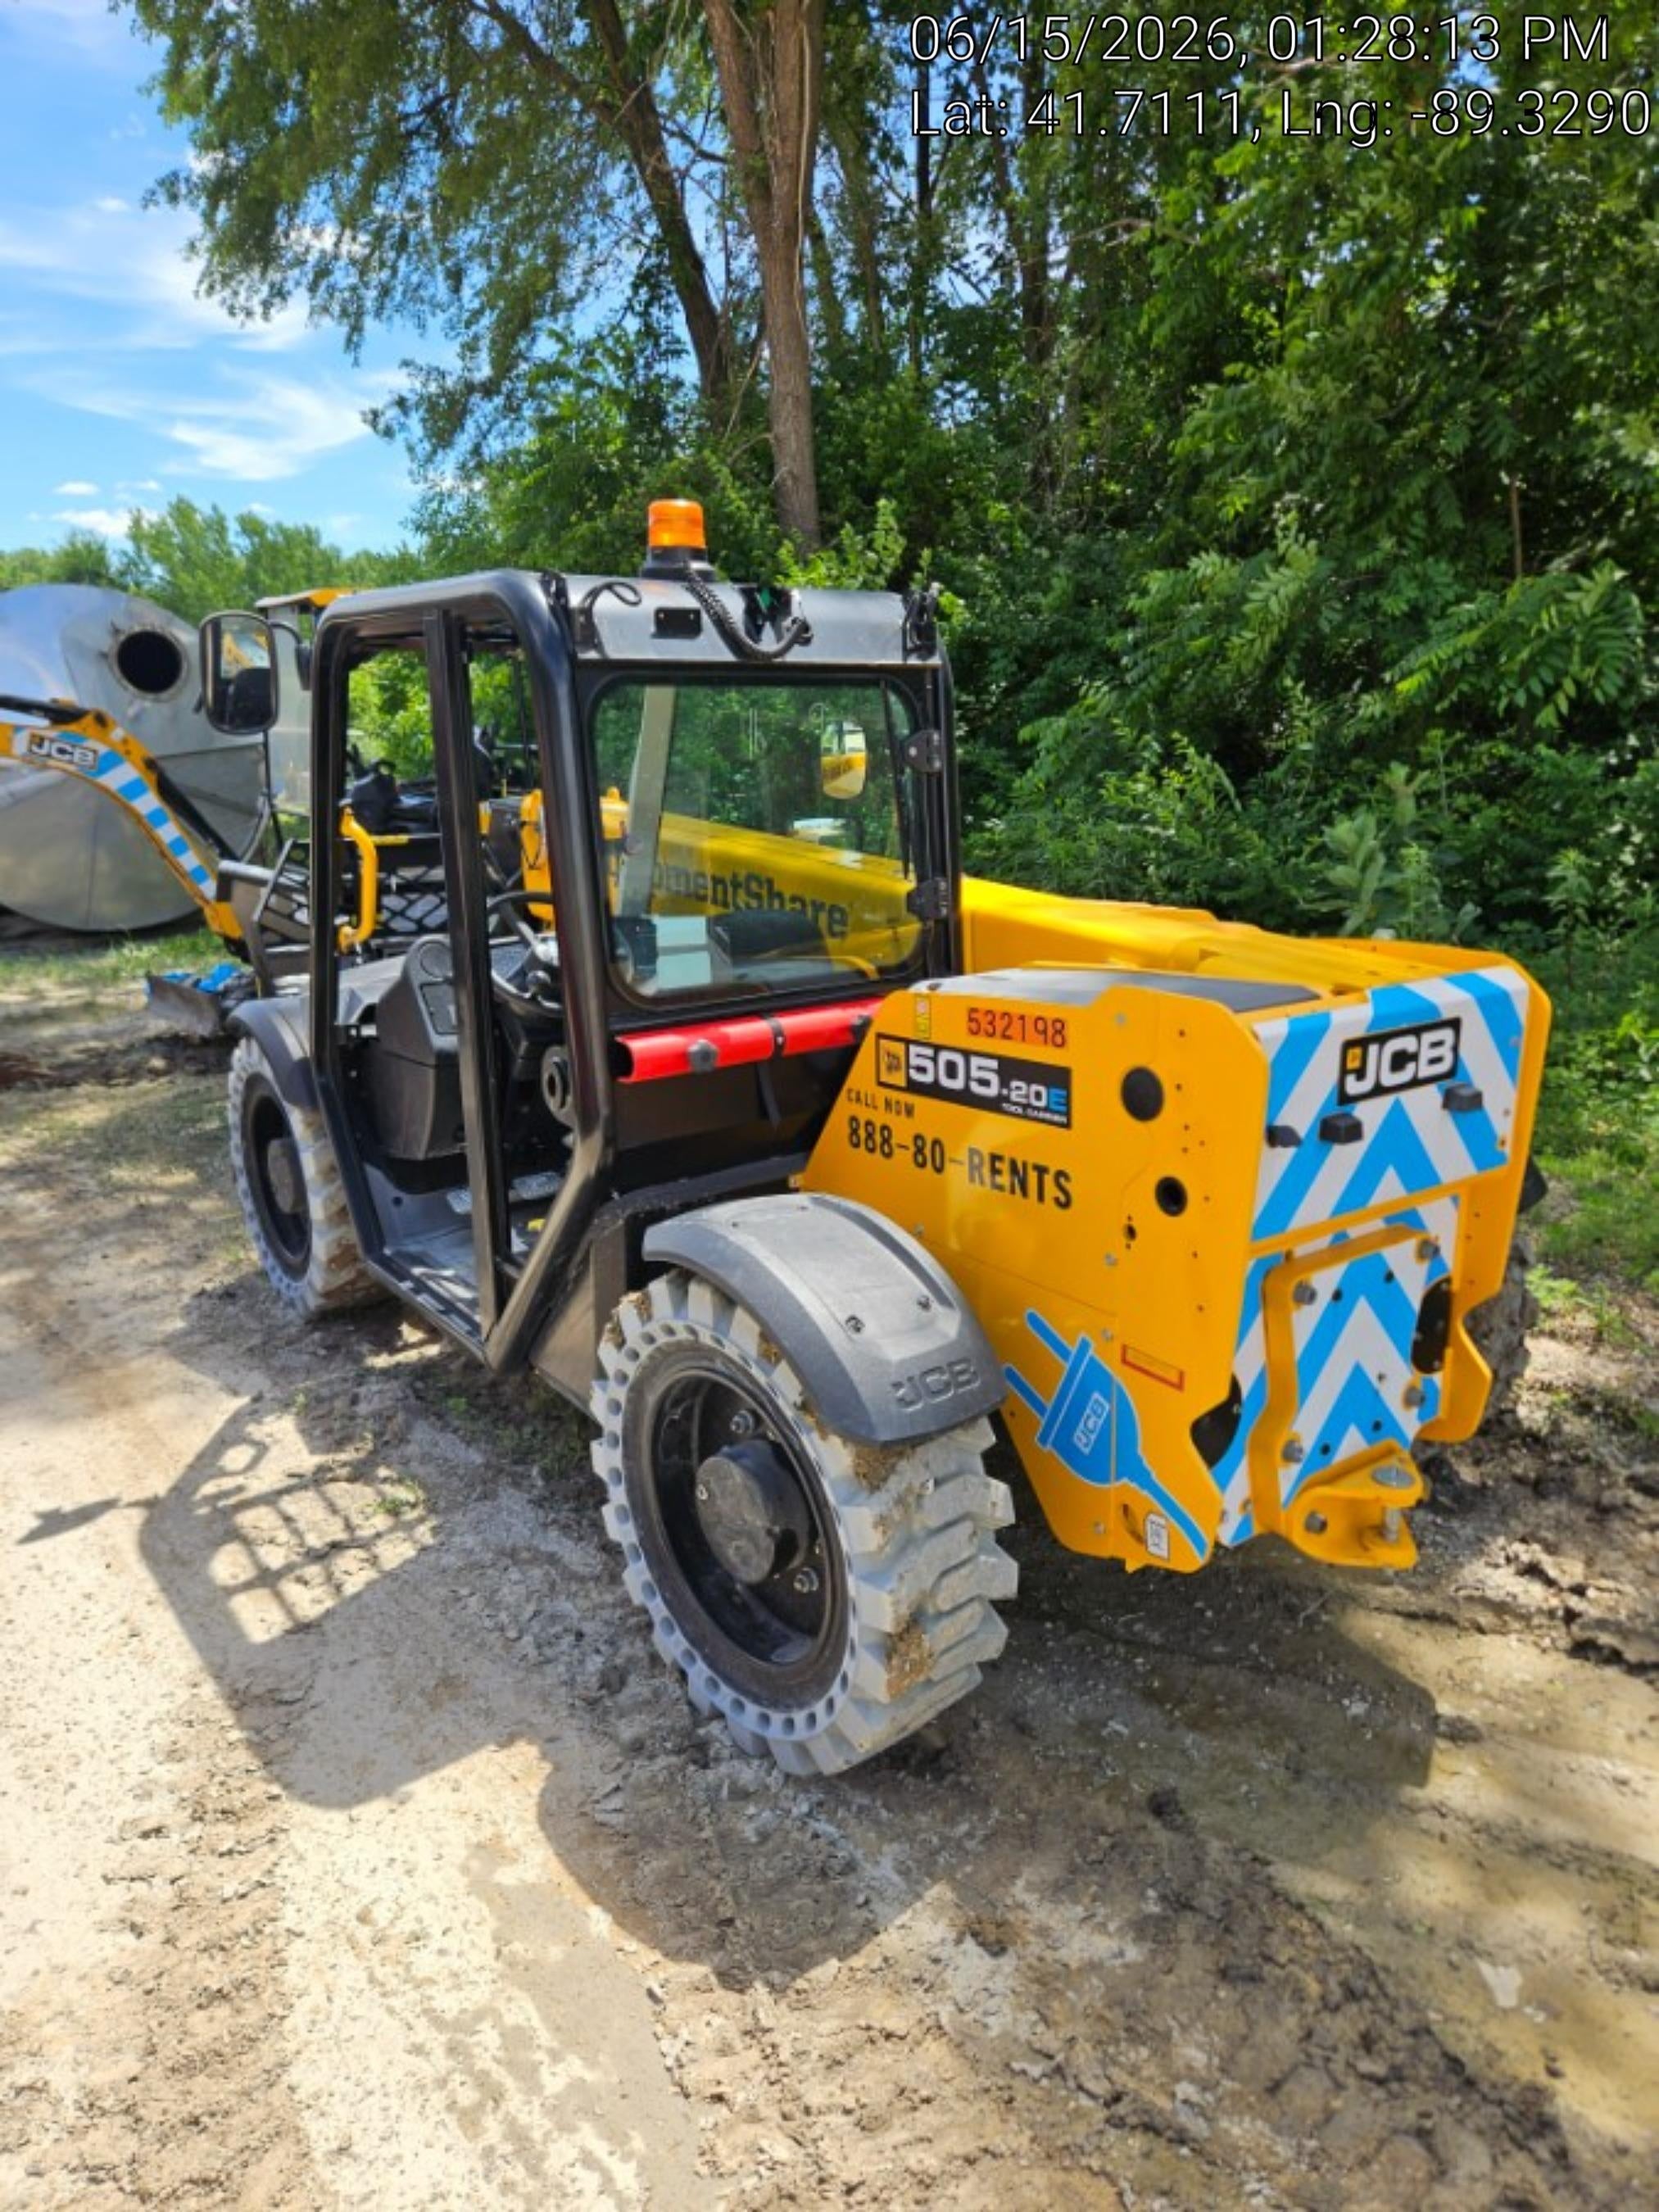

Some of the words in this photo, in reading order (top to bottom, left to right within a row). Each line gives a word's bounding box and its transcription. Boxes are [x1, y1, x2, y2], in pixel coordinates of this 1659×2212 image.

[31, 737, 94, 765] JCB
[967, 1007, 1067, 1048] 532198
[1344, 1026, 1456, 1096] JCB
[847, 1088, 878, 1110] CALL
[884, 1095, 915, 1118] NOW
[847, 1115, 1072, 1210] 888-80-RENTS
[891, 1357, 981, 1412] JCB
